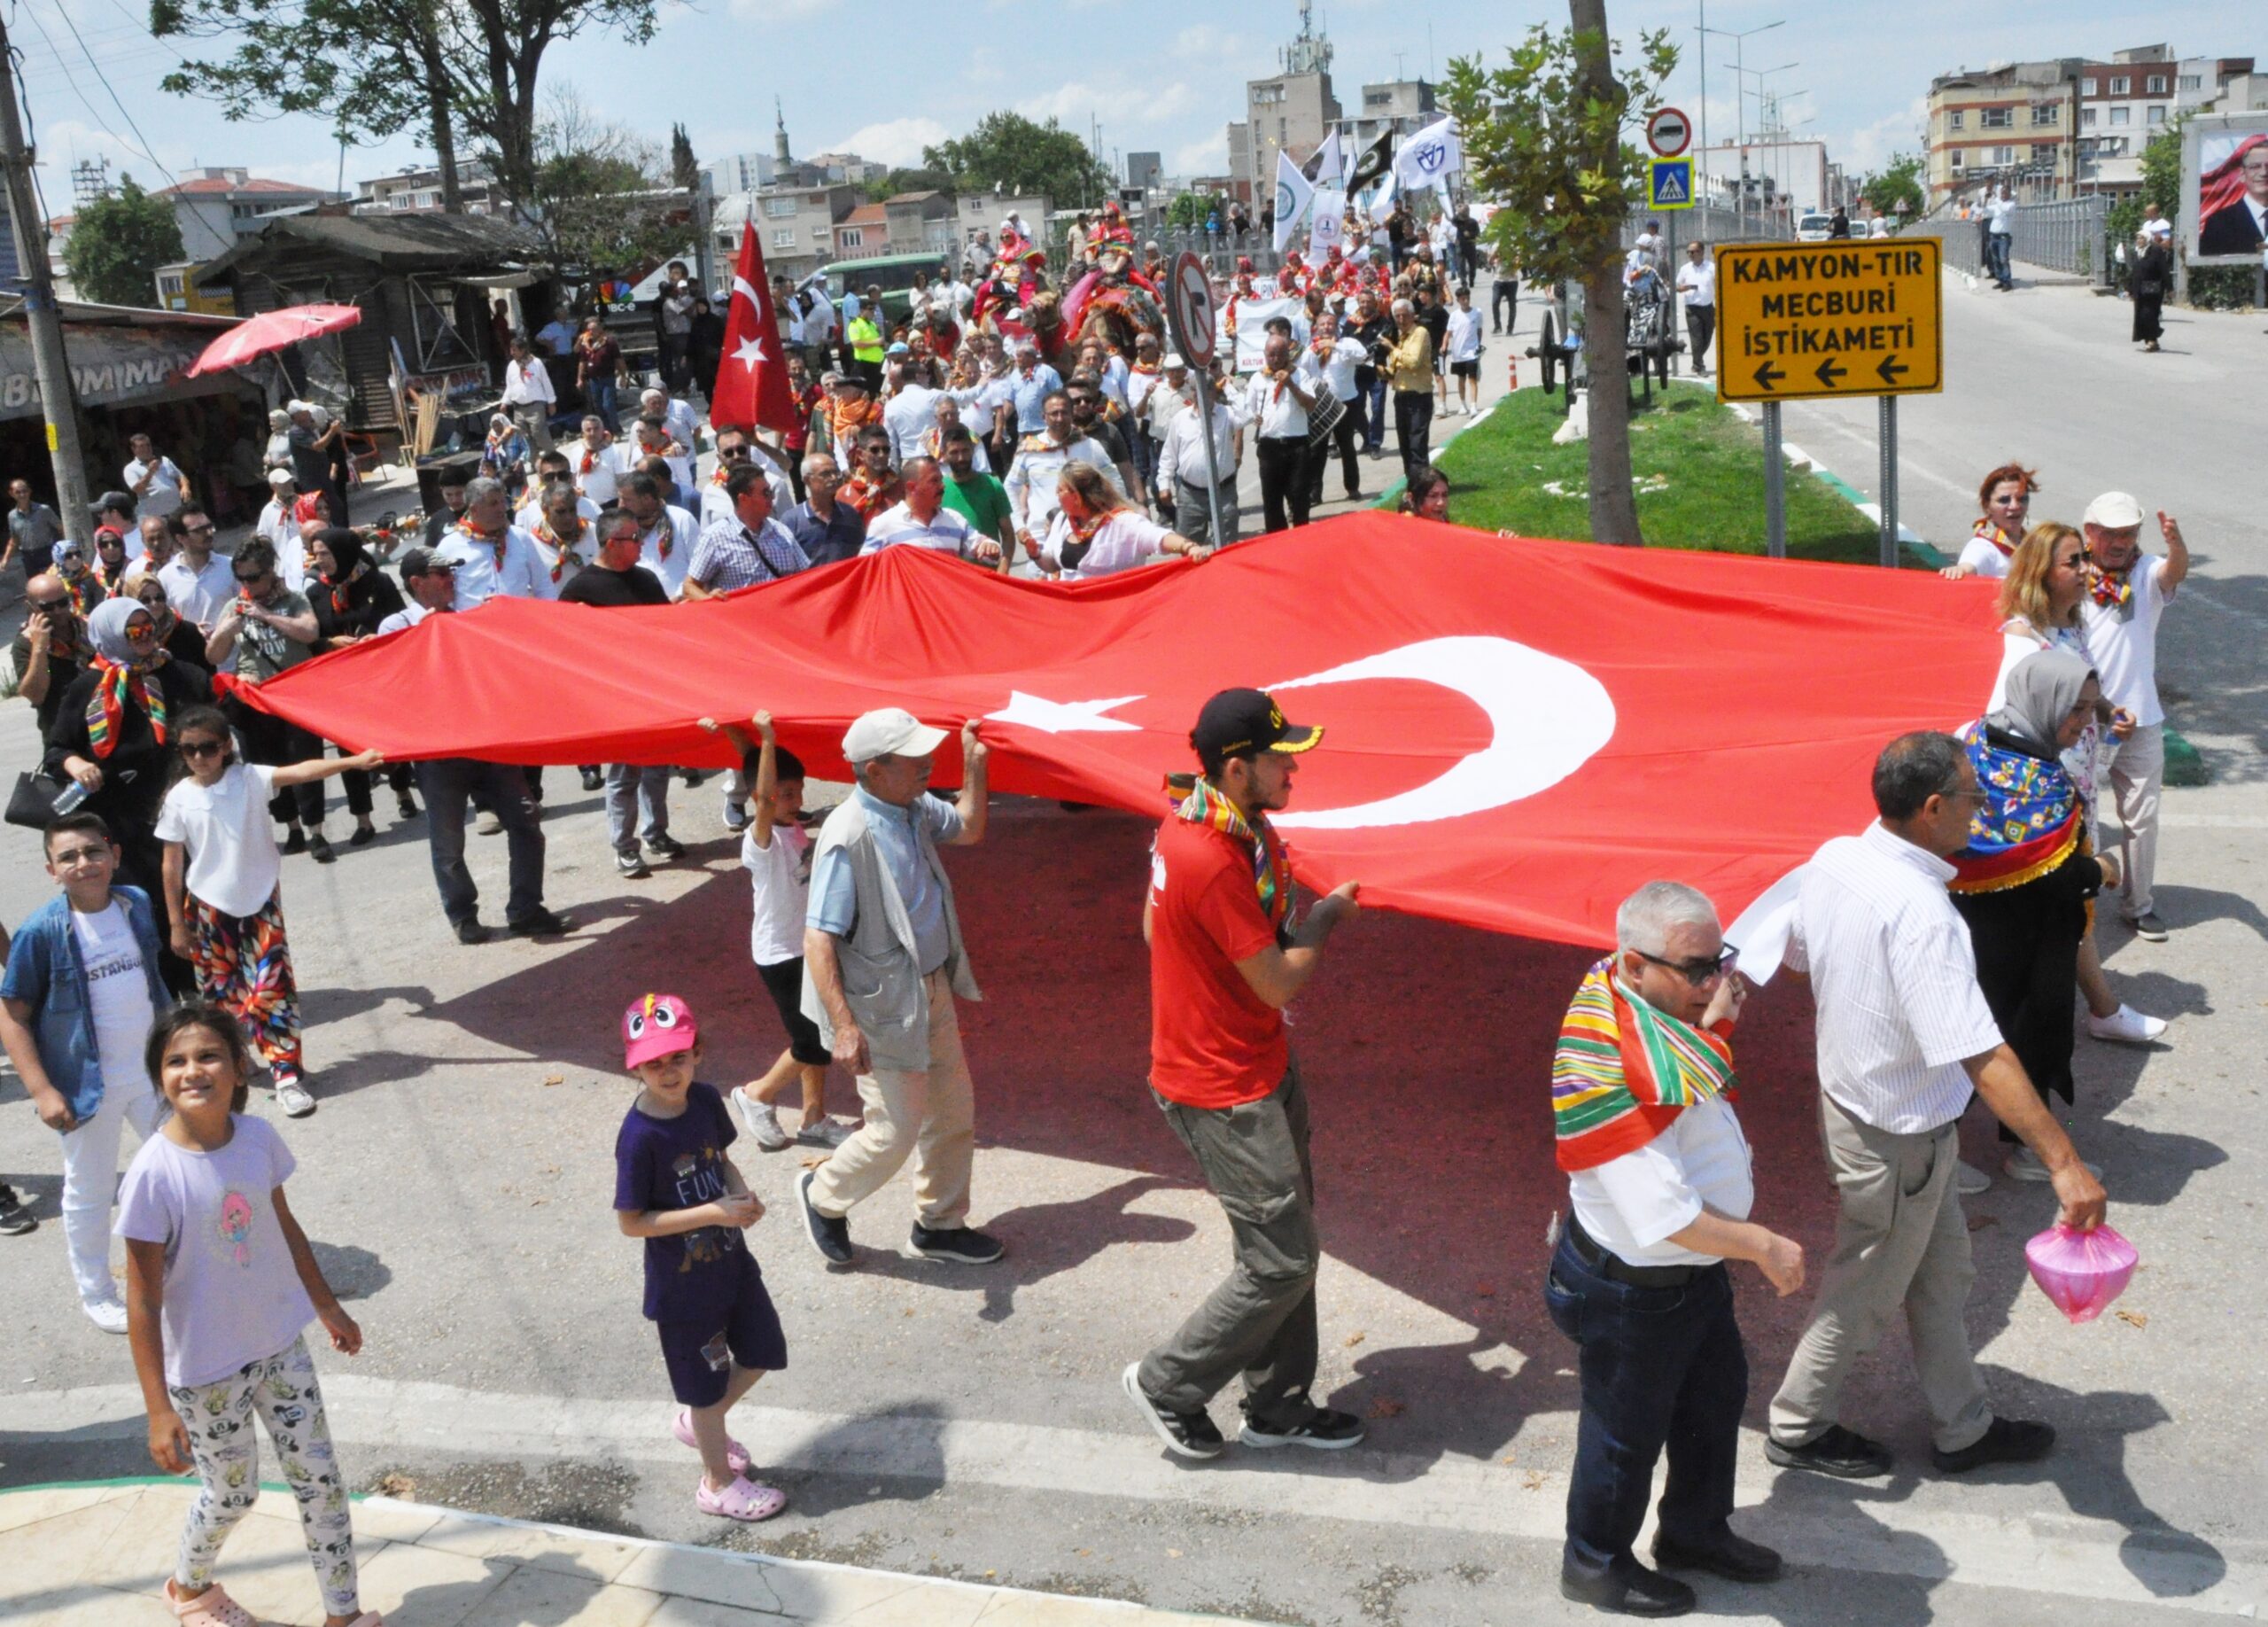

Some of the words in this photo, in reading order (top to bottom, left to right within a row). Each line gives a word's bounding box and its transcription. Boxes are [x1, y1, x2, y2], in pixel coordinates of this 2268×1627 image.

[1733, 250, 1922, 284] KAMYON-TIR
[594, 302, 636, 313] CBC-e
[1761, 282, 1896, 319] MECBURİ
[1744, 317, 1915, 356] İSTİKAMETİ
[676, 1166, 723, 1205] FUN
